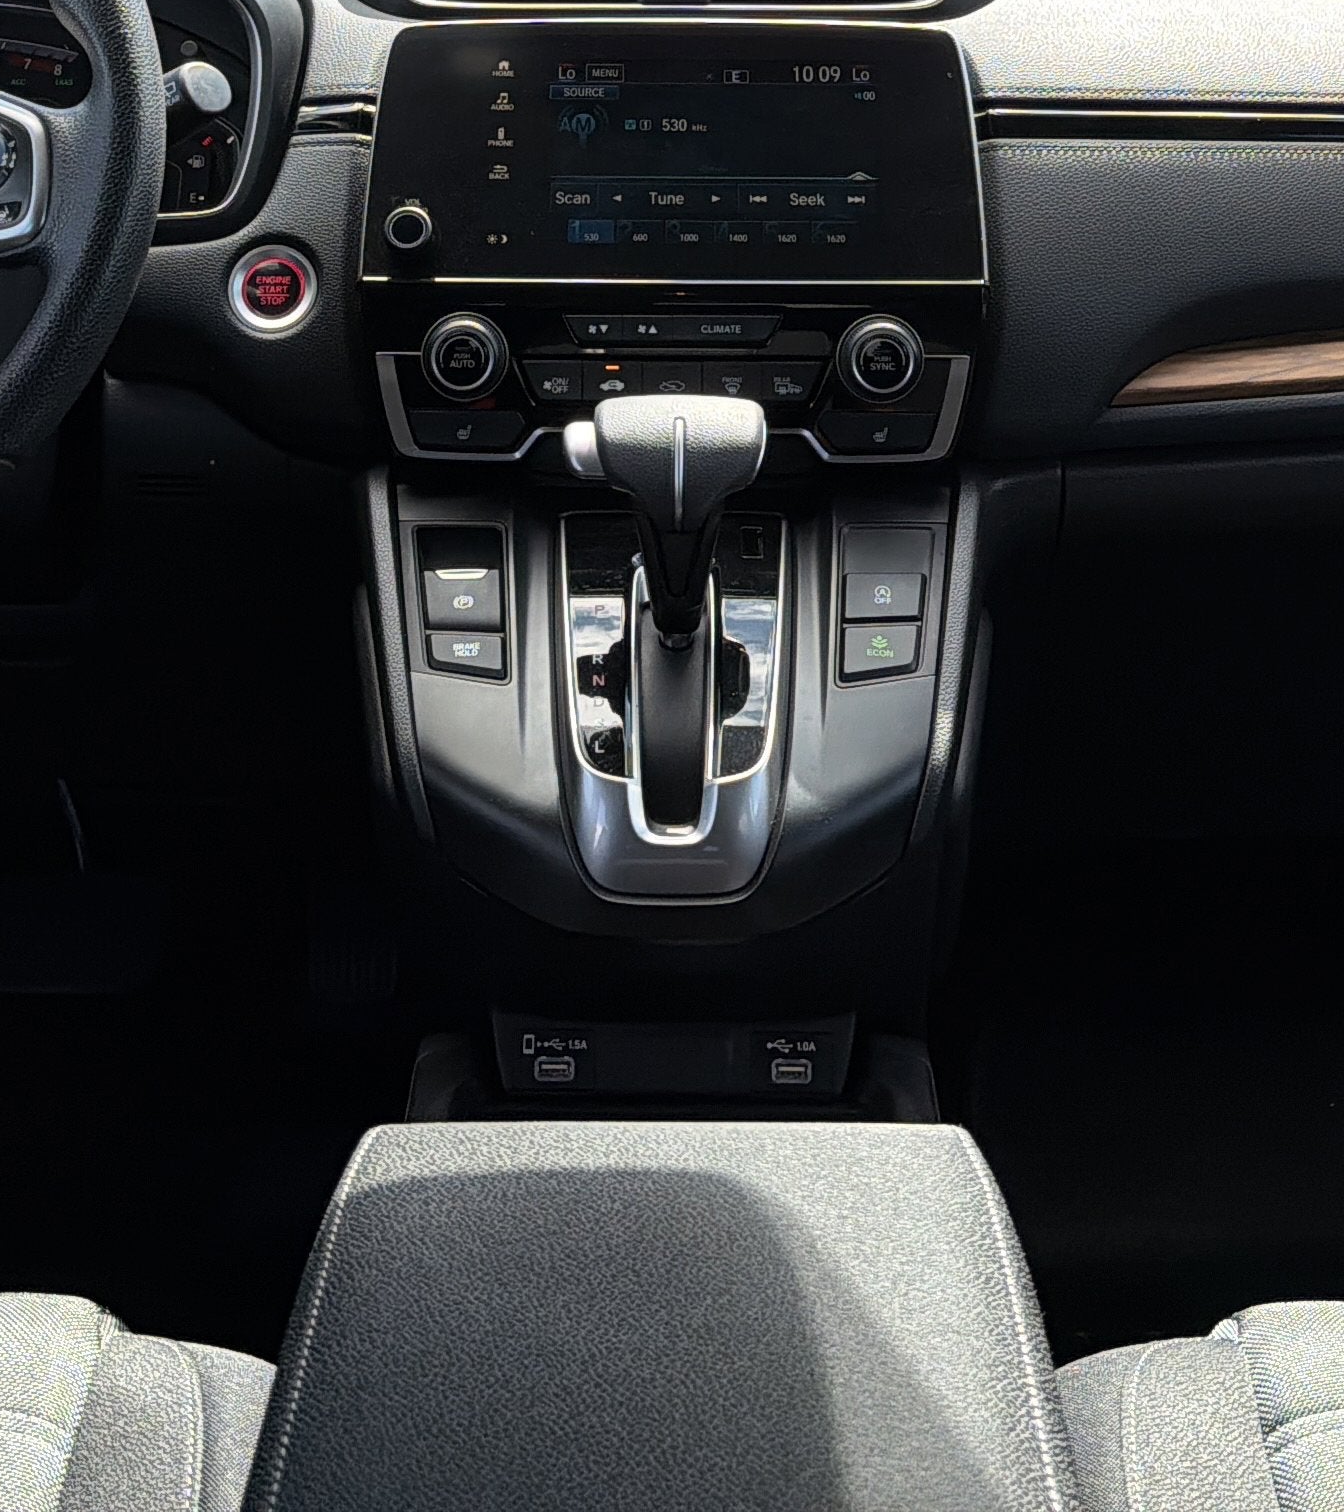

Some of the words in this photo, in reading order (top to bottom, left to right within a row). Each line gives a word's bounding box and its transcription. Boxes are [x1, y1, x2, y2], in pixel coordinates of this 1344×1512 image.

[23, 58, 32, 71] 7
[53, 64, 62, 76] 8
[559, 66, 576, 80] Lo
[592, 68, 619, 78] MENU
[732, 70, 742, 83] E
[852, 67, 871, 81] Lo
[563, 87, 606, 97] SOURCE
[661, 118, 688, 132] 530
[487, 139, 514, 147] PHONE
[556, 192, 591, 205] Scan
[649, 192, 685, 205] Tune
[789, 192, 825, 206] Seek
[583, 233, 599, 242] 530
[632, 233, 648, 242] 600
[679, 233, 699, 243] 1000
[728, 233, 748, 243] 1400
[777, 234, 797, 243] 1620
[826, 234, 846, 244] 1620
[256, 276, 292, 285] ENGINE
[258, 285, 289, 294] START
[260, 296, 286, 305] STOP
[700, 324, 742, 334] CLIMATE
[449, 360, 476, 369] AUTO
[870, 362, 896, 371] SYNC
[552, 385, 569, 394] OFF
[874, 597, 892, 605] OFF
[594, 604, 605, 614] P
[453, 642, 481, 650] BRAKE
[454, 649, 479, 657] HOLD
[866, 649, 894, 658] ECON
[592, 654, 604, 665] R
[592, 674, 605, 687] N
[593, 696, 605, 707] D
[594, 740, 605, 754] L
[567, 1039, 588, 1050] 1.5A
[796, 1040, 817, 1052] 1.0A
